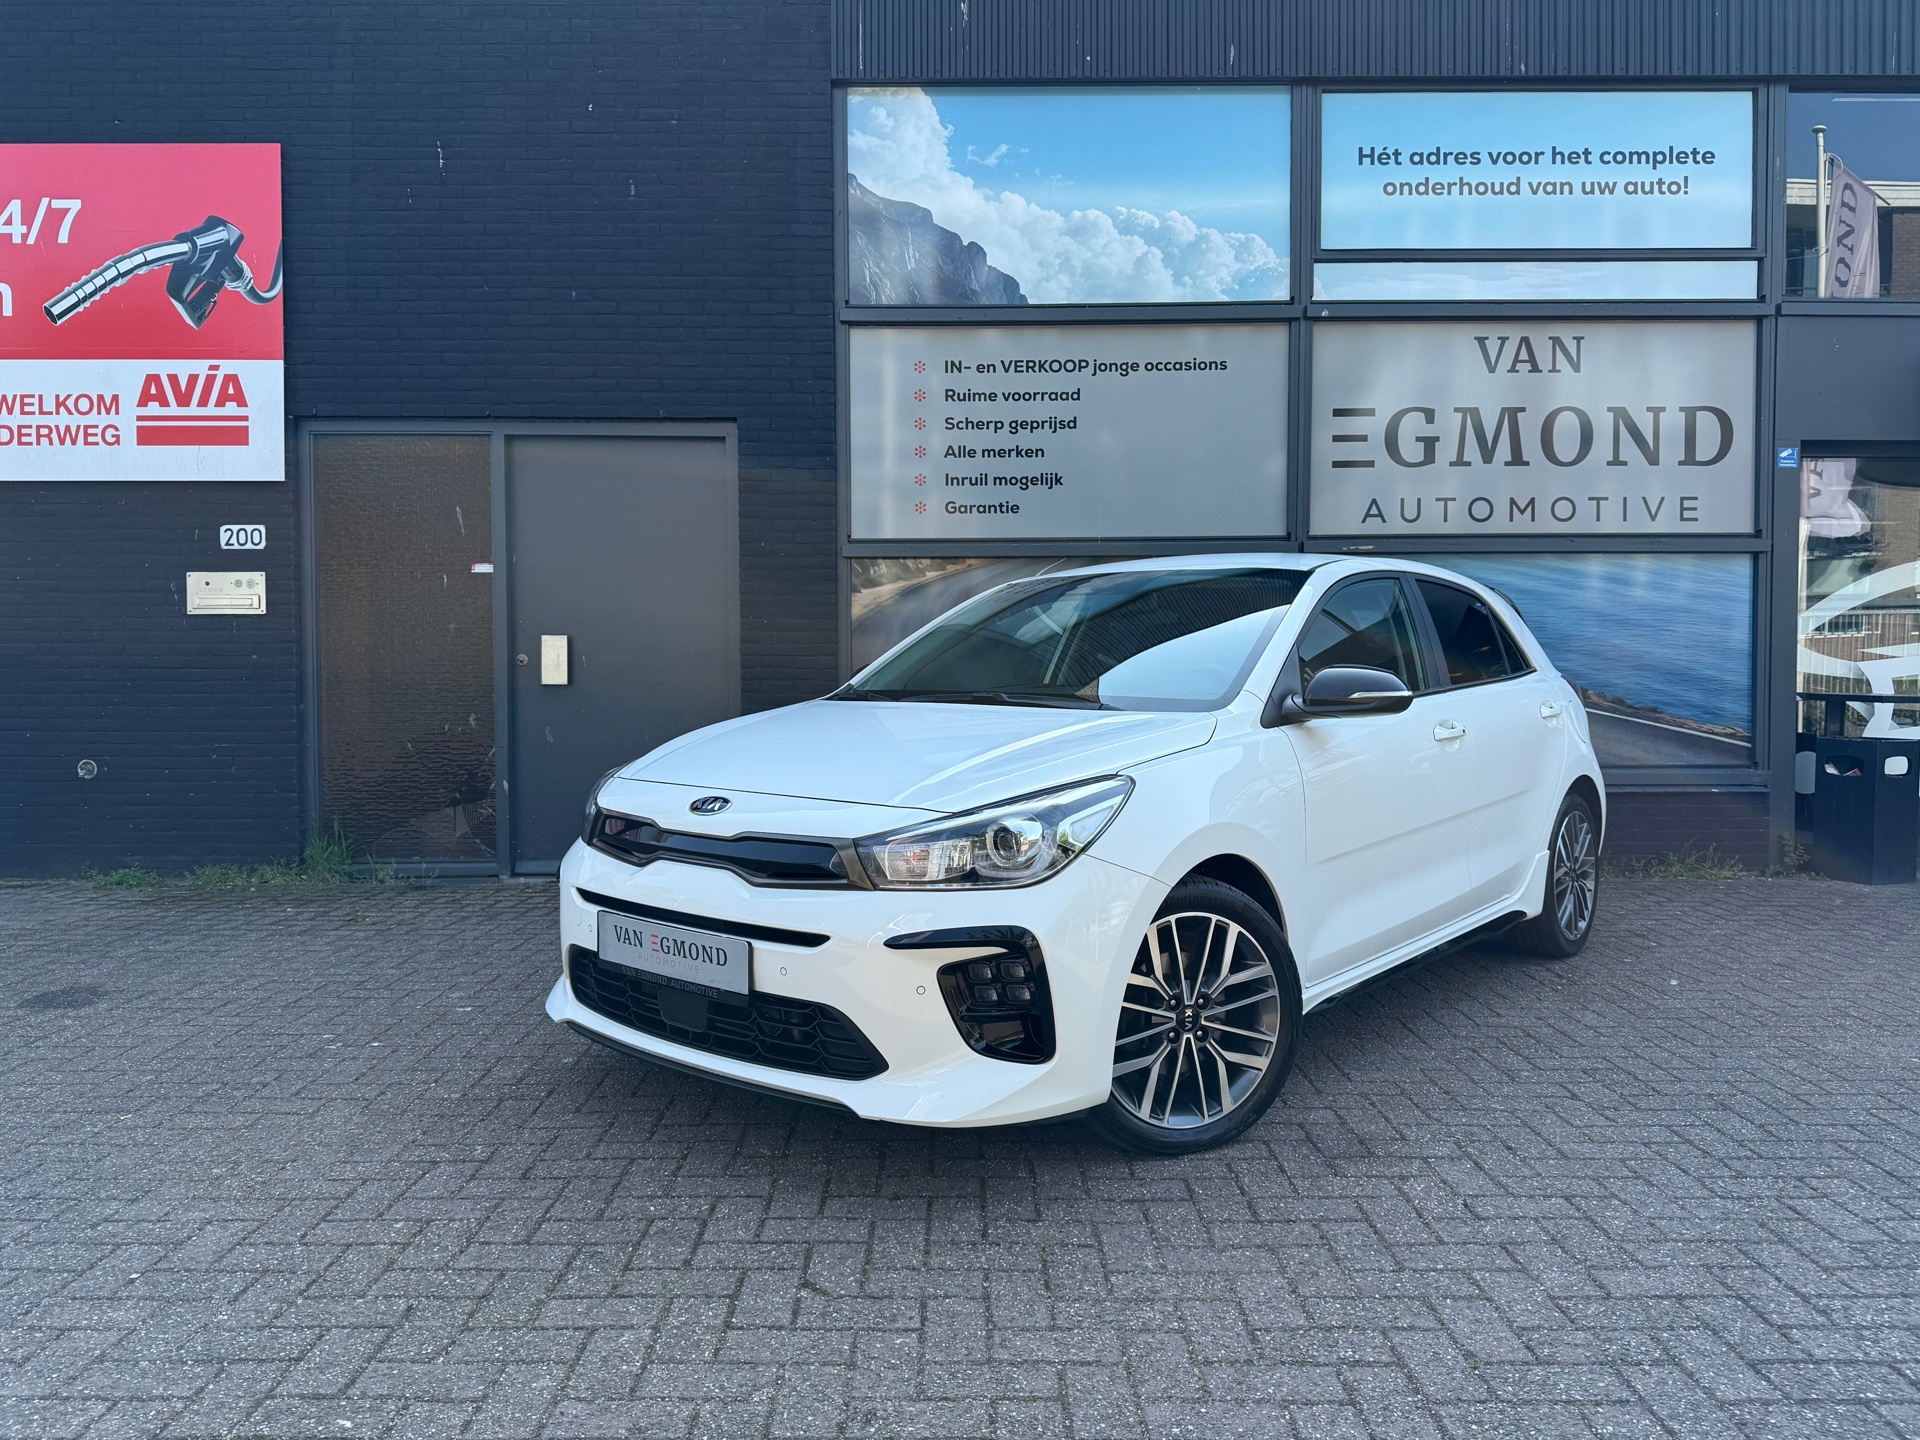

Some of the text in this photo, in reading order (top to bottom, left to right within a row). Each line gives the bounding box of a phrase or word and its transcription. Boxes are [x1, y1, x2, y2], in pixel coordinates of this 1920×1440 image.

[1358, 146, 1716, 171] Hét adres voor het complete
[1382, 175, 1689, 197] onderhoud van uw auto!
[0, 197, 82, 244] 4/7
[1474, 335, 1585, 374] VAN
[944, 358, 1228, 378] IN- en VERKOOP jonge occasions
[136, 365, 249, 408] AVIA
[944, 388, 1081, 403] Ruime voorraad
[0, 393, 120, 416] WELKOM
[0, 424, 121, 447] DERWEG
[944, 415, 1078, 435] Scherp geprijsd
[1331, 405, 1734, 469] EGMOND
[943, 444, 1045, 459] Alle merken
[944, 472, 1064, 491] Inruil mogelijk
[944, 500, 1020, 515] Garantie
[1360, 496, 1700, 524] AUTOMOTIVE
[223, 527, 263, 547] 200
[692, 797, 724, 811] KIA
[613, 924, 728, 967] VAN EGMOND
[637, 952, 700, 974] AUTOMOTIVE
[622, 966, 636, 977] VAN
[670, 979, 718, 999] AUTOMOTIVE
